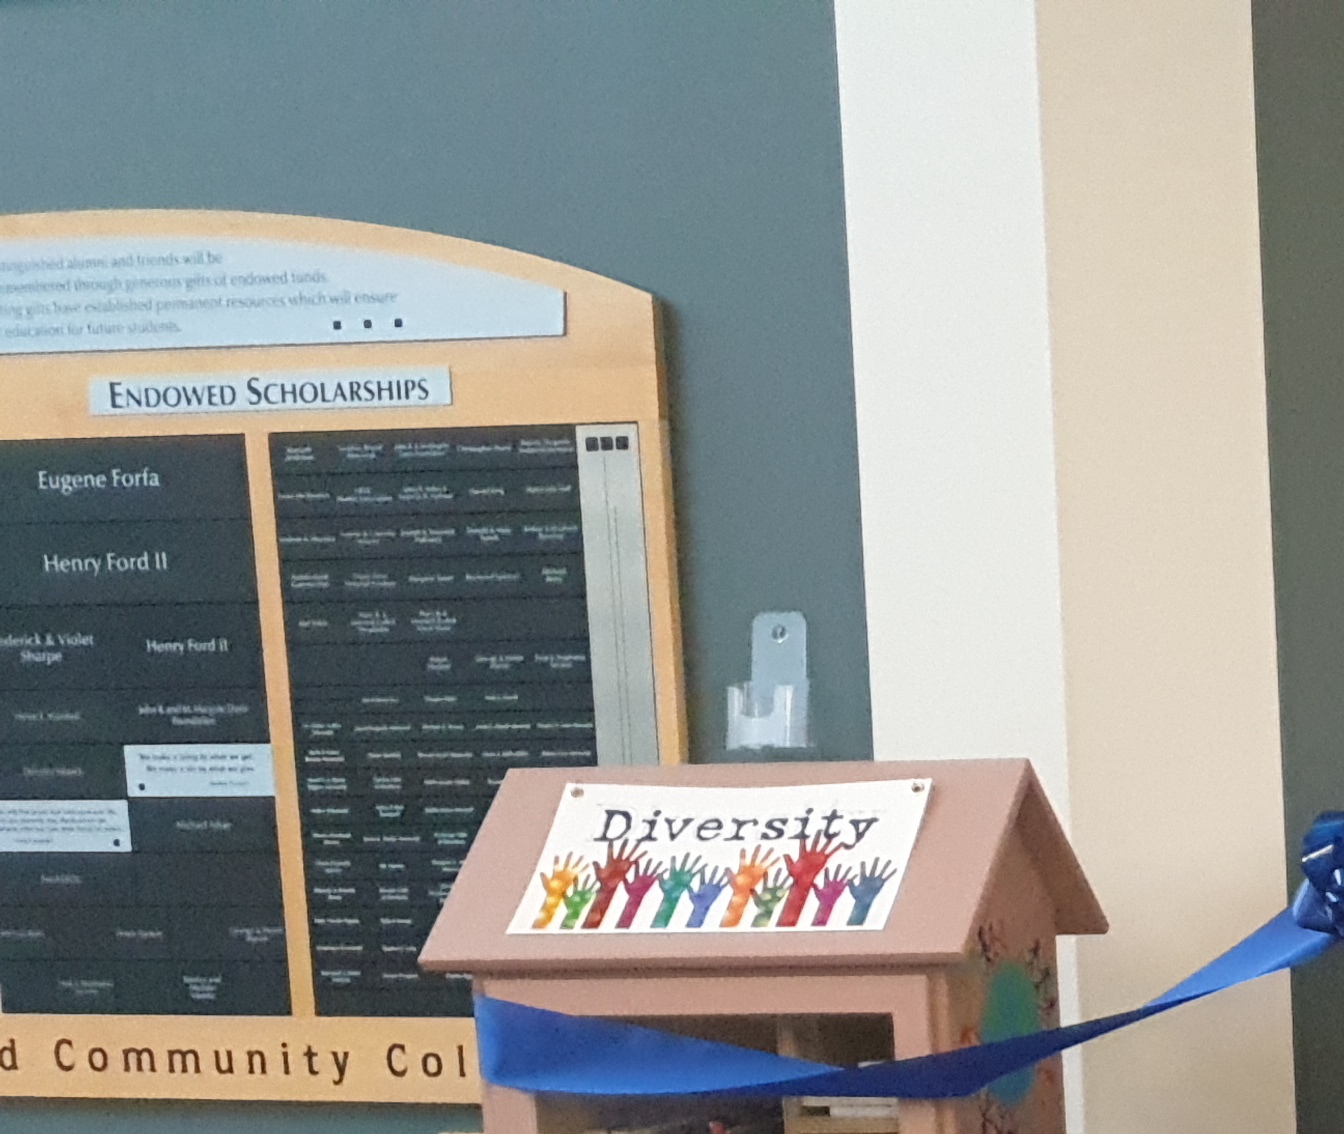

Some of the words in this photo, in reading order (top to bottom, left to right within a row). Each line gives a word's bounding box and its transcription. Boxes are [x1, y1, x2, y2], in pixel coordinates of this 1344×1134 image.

[231, 271, 287, 286] endowed
[109, 381, 236, 409] ENDOWED
[247, 377, 429, 405] SCHOLARSHIPS
[38, 469, 107, 496] Eugene
[111, 466, 160, 488] Forfa
[44, 553, 101, 577] Henry
[106, 550, 149, 572] Ford
[146, 638, 184, 655] Henry
[188, 637, 216, 652] Ford
[593, 806, 880, 849] Diversity
[54, 1037, 350, 1085] Community
